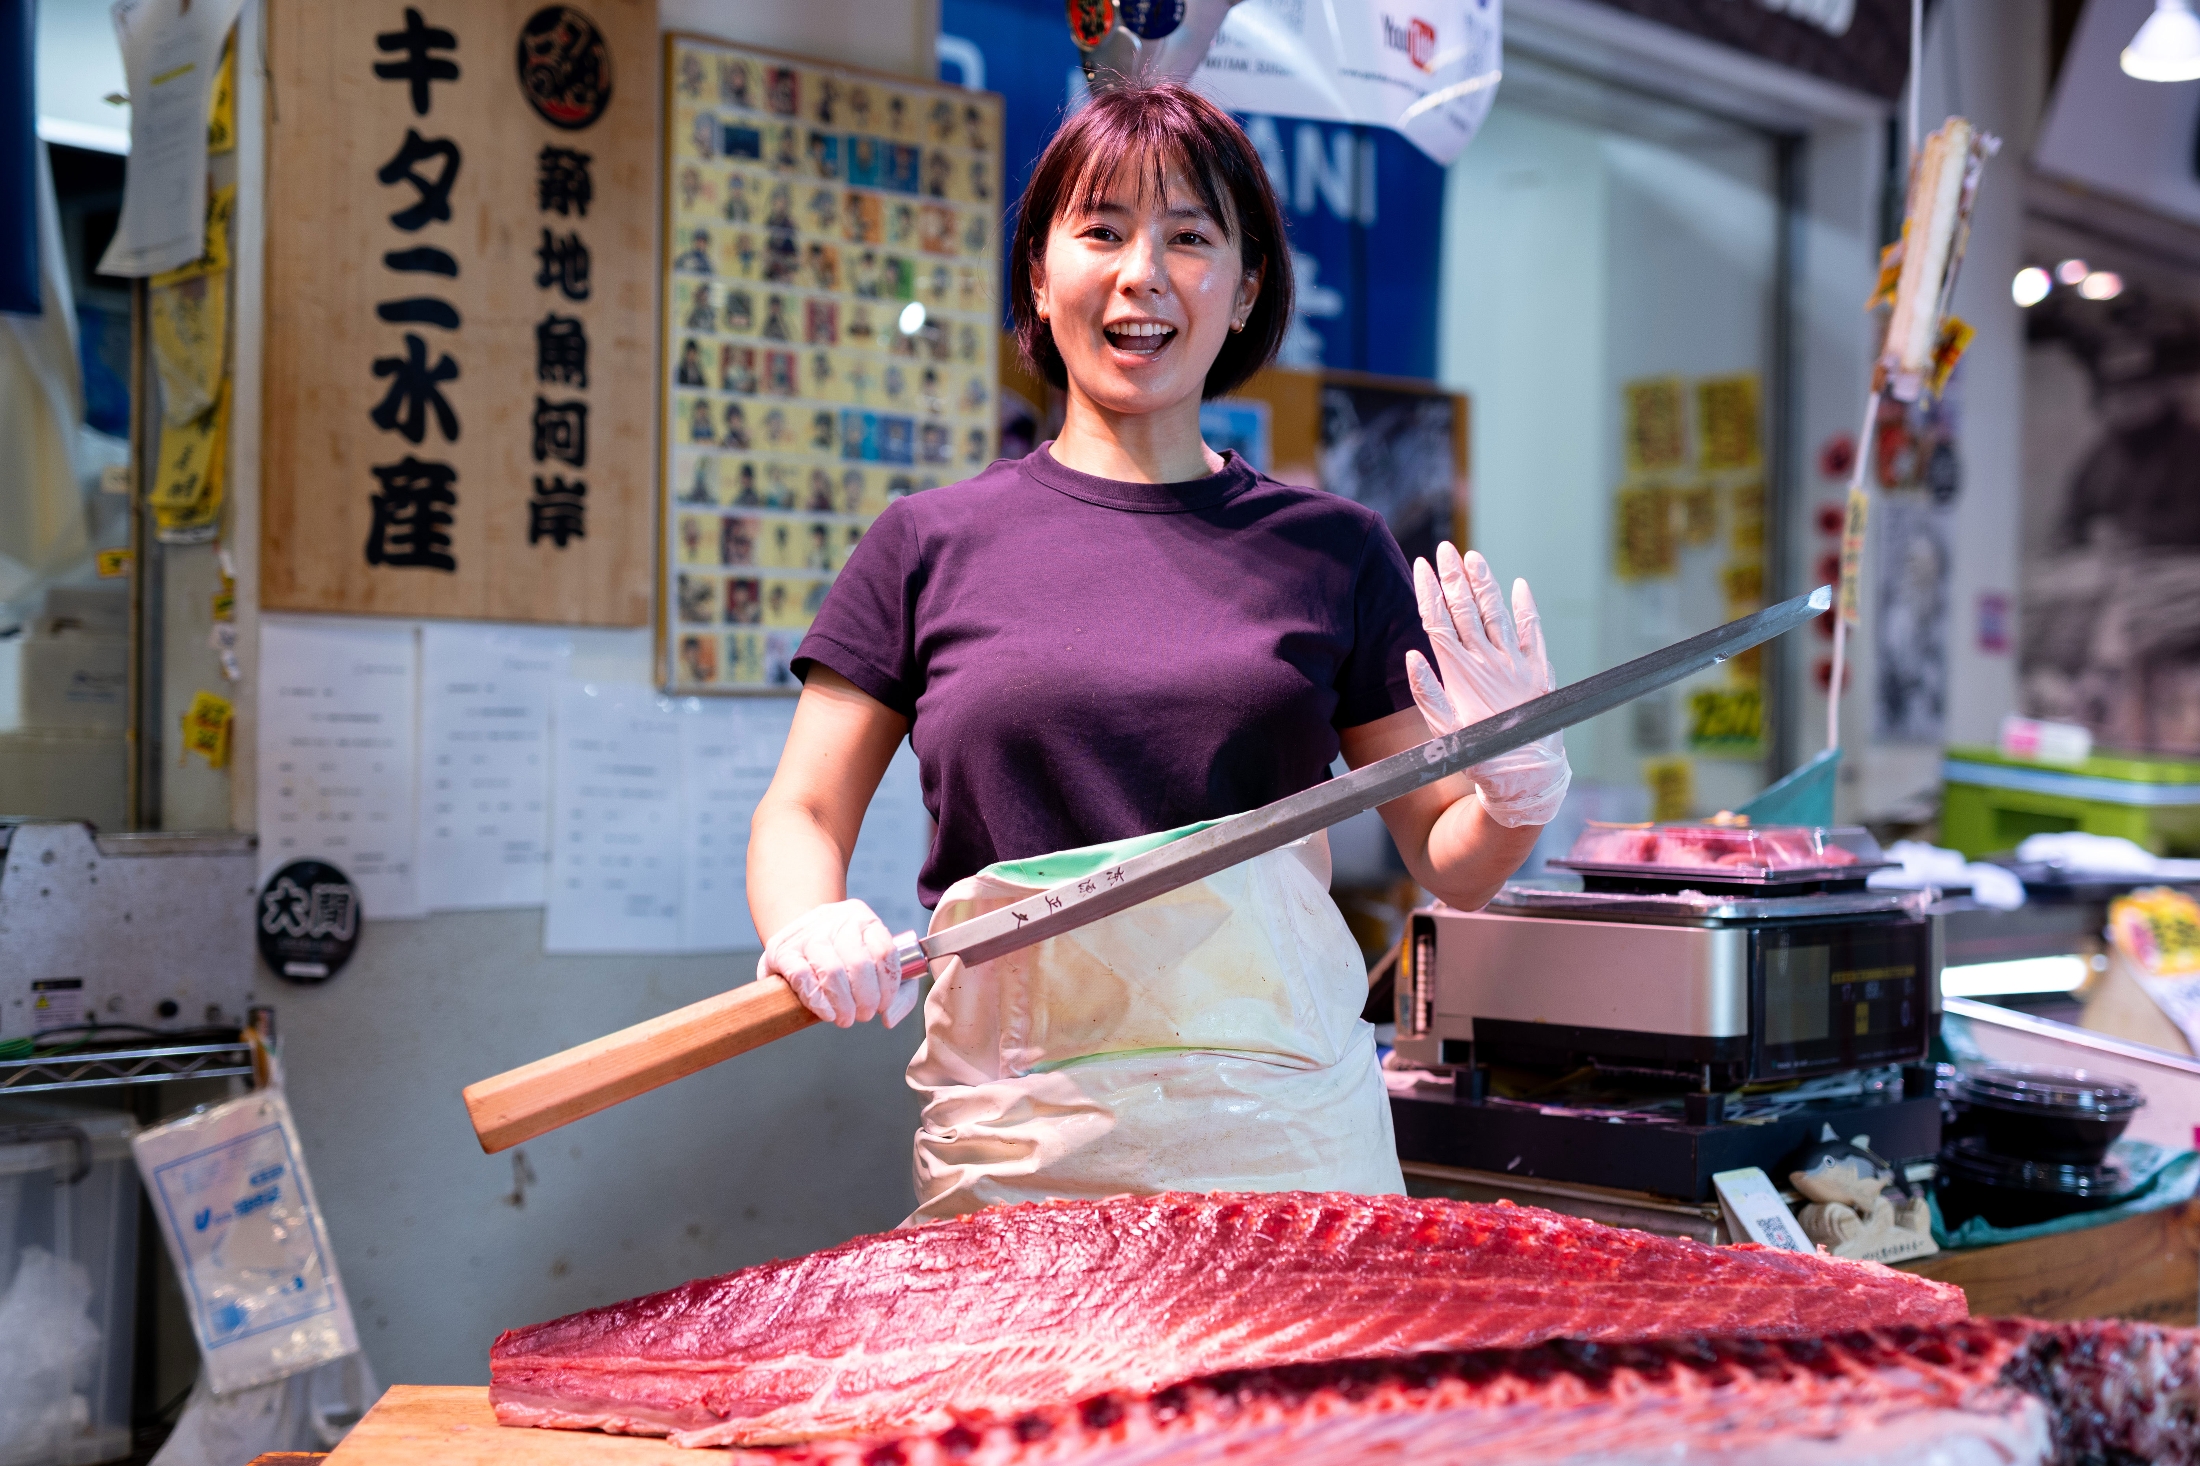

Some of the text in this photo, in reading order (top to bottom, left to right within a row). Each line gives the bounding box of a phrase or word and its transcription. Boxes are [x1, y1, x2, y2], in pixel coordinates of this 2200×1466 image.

[364, 7, 461, 574] キタニ水産
[527, 143, 593, 549] 築地魚河岸
[1246, 116, 1378, 228] ANI
